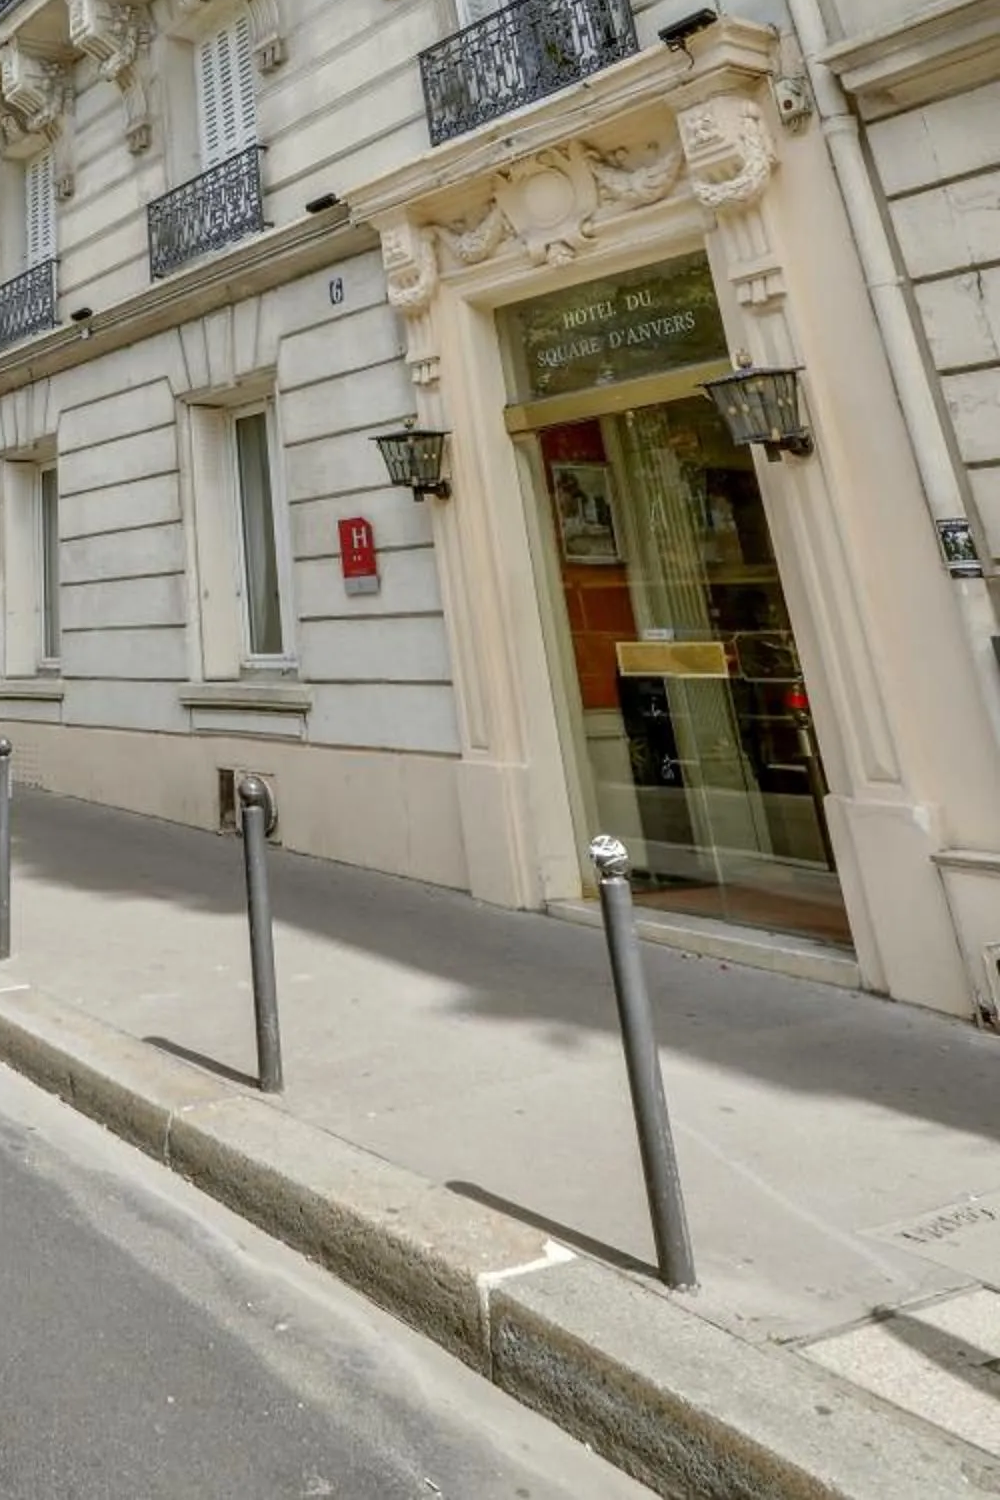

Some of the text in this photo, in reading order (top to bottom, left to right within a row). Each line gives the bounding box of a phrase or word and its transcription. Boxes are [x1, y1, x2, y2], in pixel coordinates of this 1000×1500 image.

[330, 278, 343, 304] 6
[627, 290, 651, 311] DU
[536, 311, 696, 367] SQUARE D'ANVERS
[352, 526, 368, 549] H
